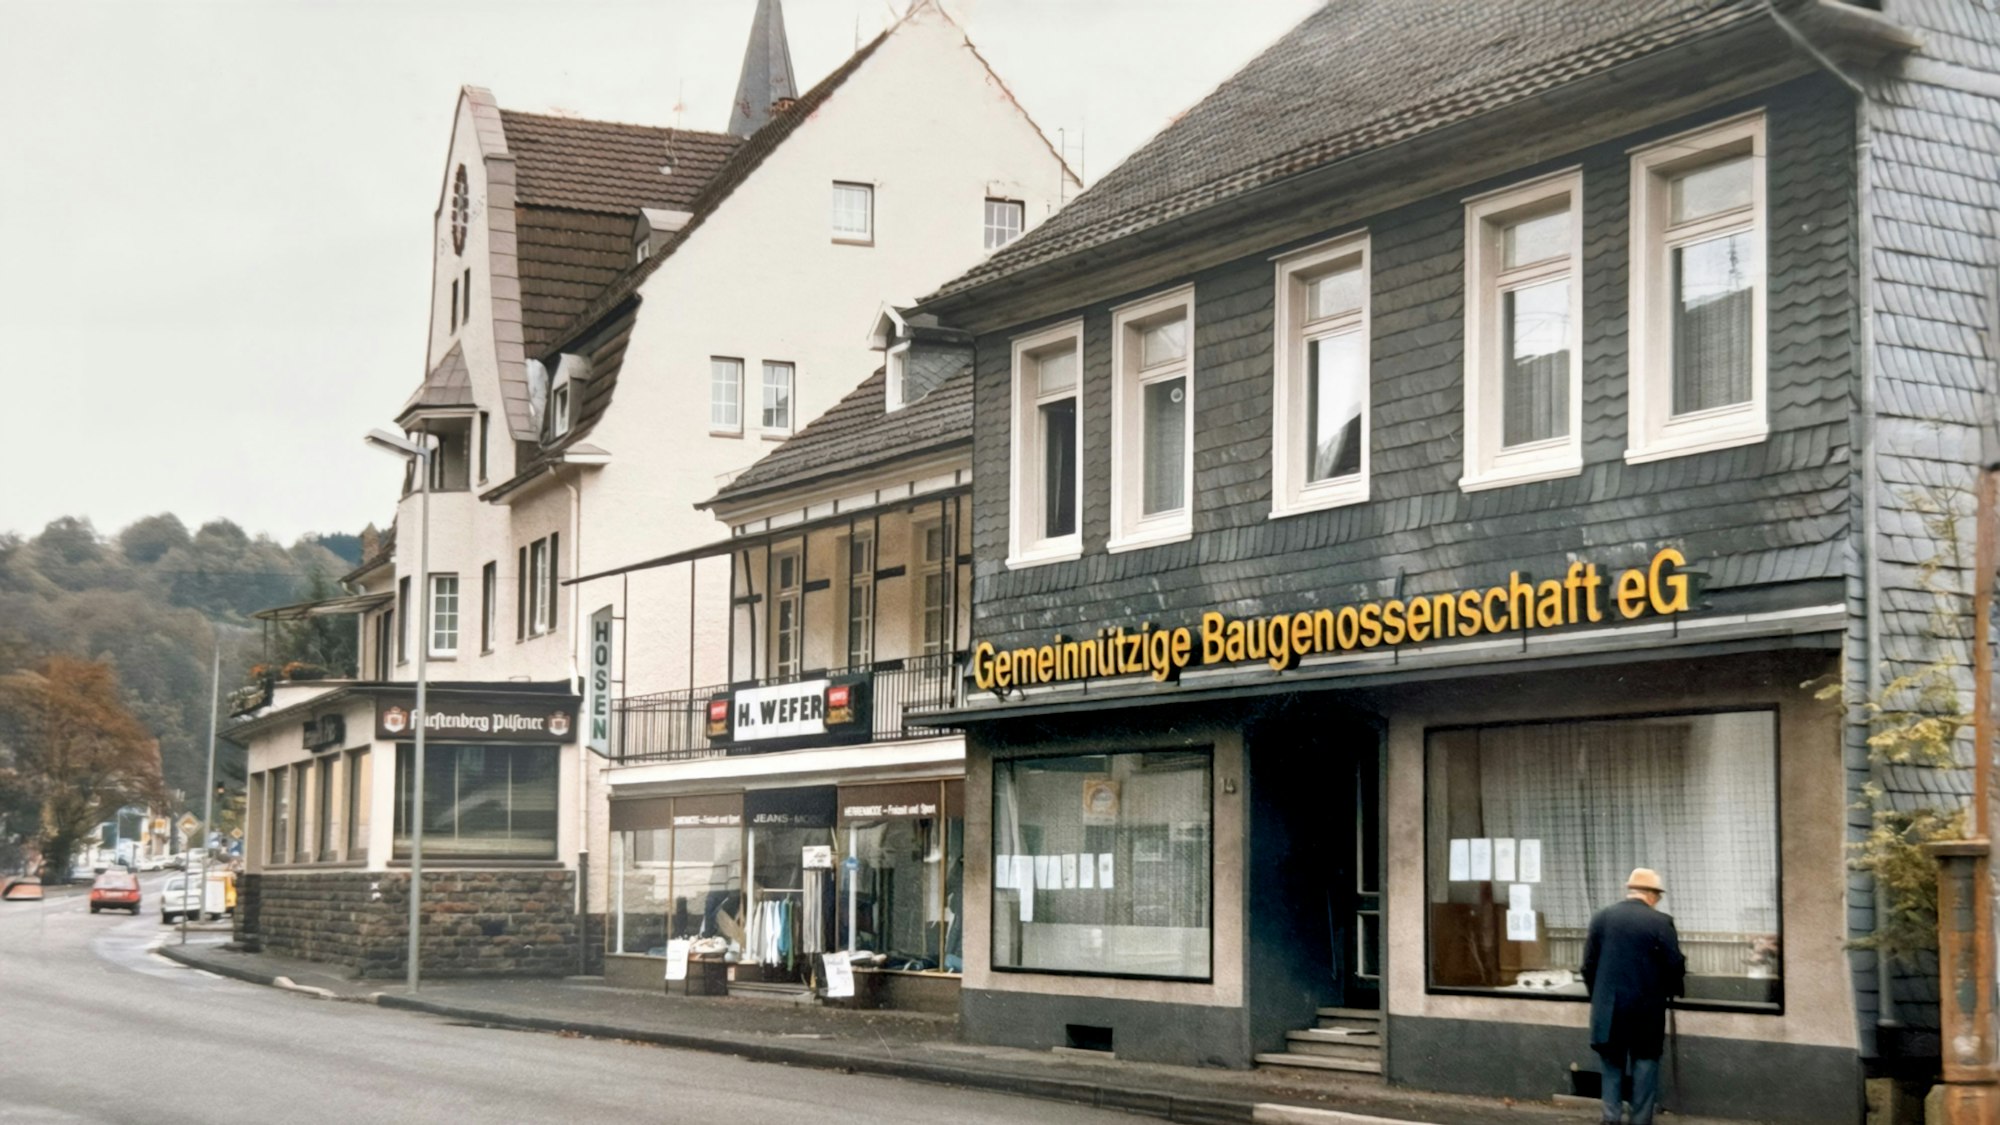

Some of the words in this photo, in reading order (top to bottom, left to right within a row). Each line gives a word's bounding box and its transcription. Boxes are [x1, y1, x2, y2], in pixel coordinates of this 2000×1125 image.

[975, 621, 1191, 689] Gemeinnützige
[1203, 561, 1603, 671] Baugenossenschaft
[1617, 548, 1688, 619] eG
[593, 621, 608, 740] HOSEN
[493, 713, 544, 733] Pilsener
[738, 703, 755, 727] H.
[760, 695, 822, 725] WEFER
[1220, 777, 1235, 793] 14
